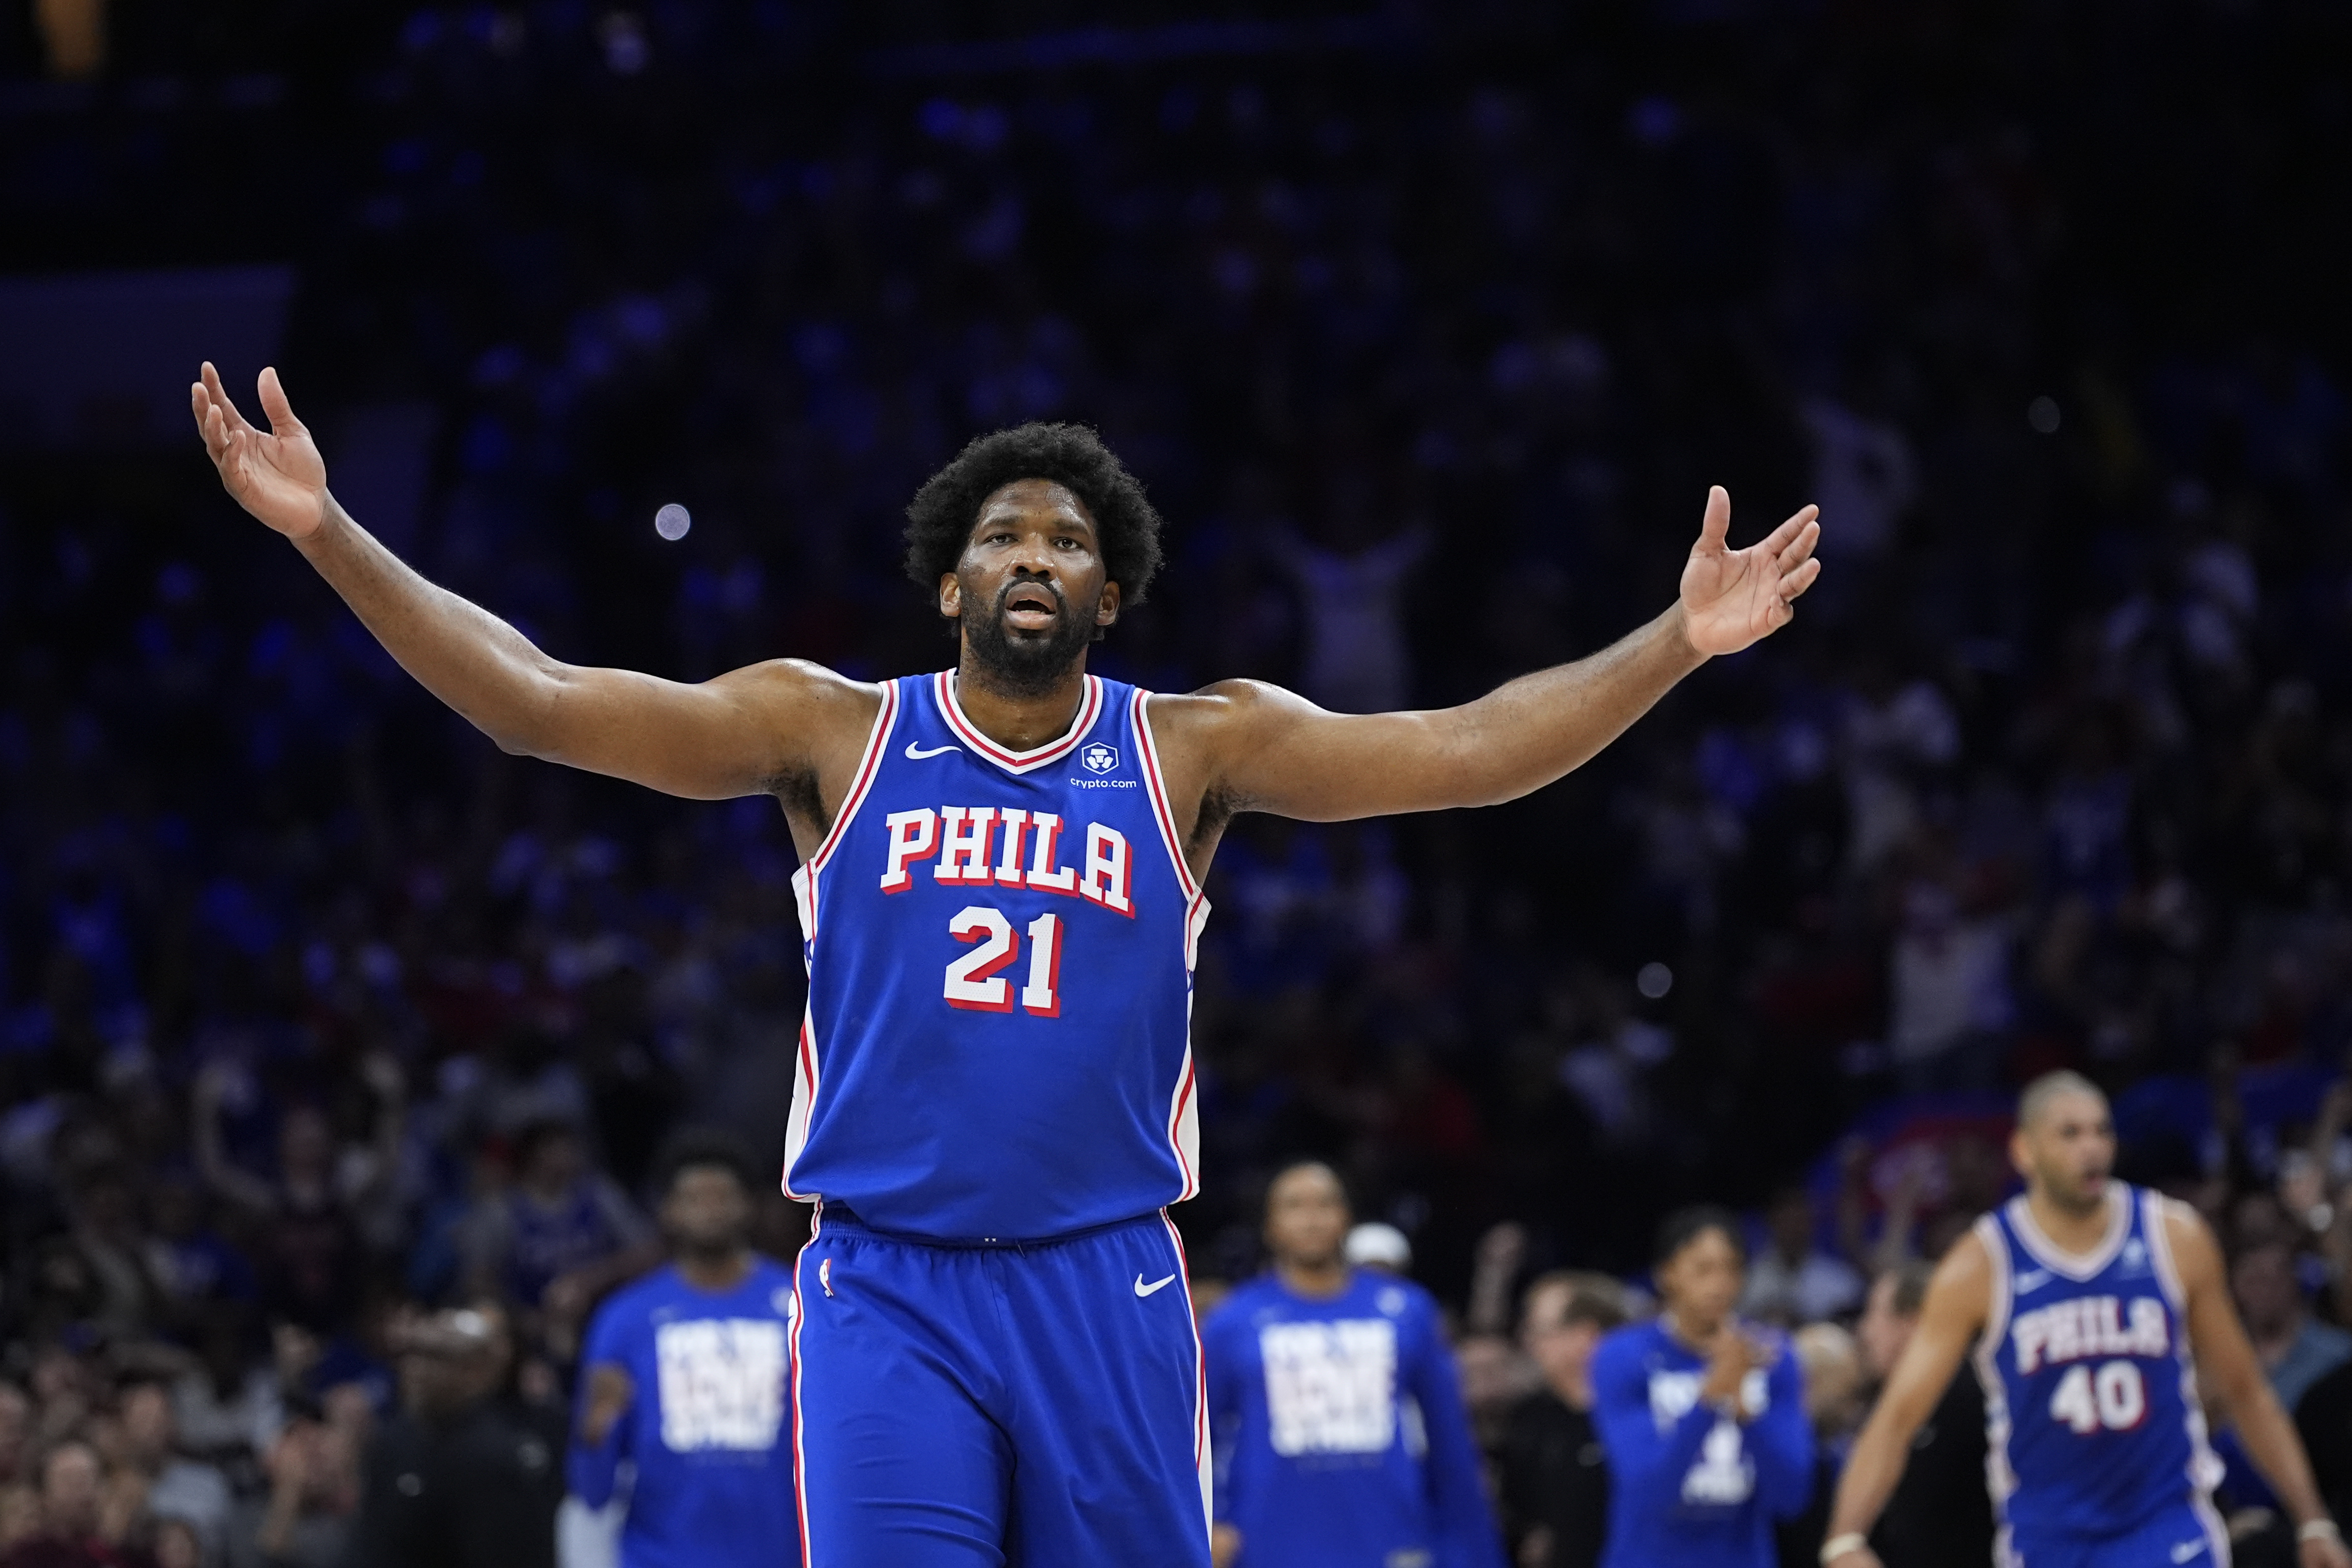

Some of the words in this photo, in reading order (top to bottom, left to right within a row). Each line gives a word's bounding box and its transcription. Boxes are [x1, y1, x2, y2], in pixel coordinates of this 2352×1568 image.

[1070, 778, 1137, 789] crypto.com
[880, 805, 1136, 919] PHILA
[944, 906, 1063, 1017] 21
[2011, 1295, 2171, 1375] PHILA
[2049, 1359, 2147, 1435] 40
